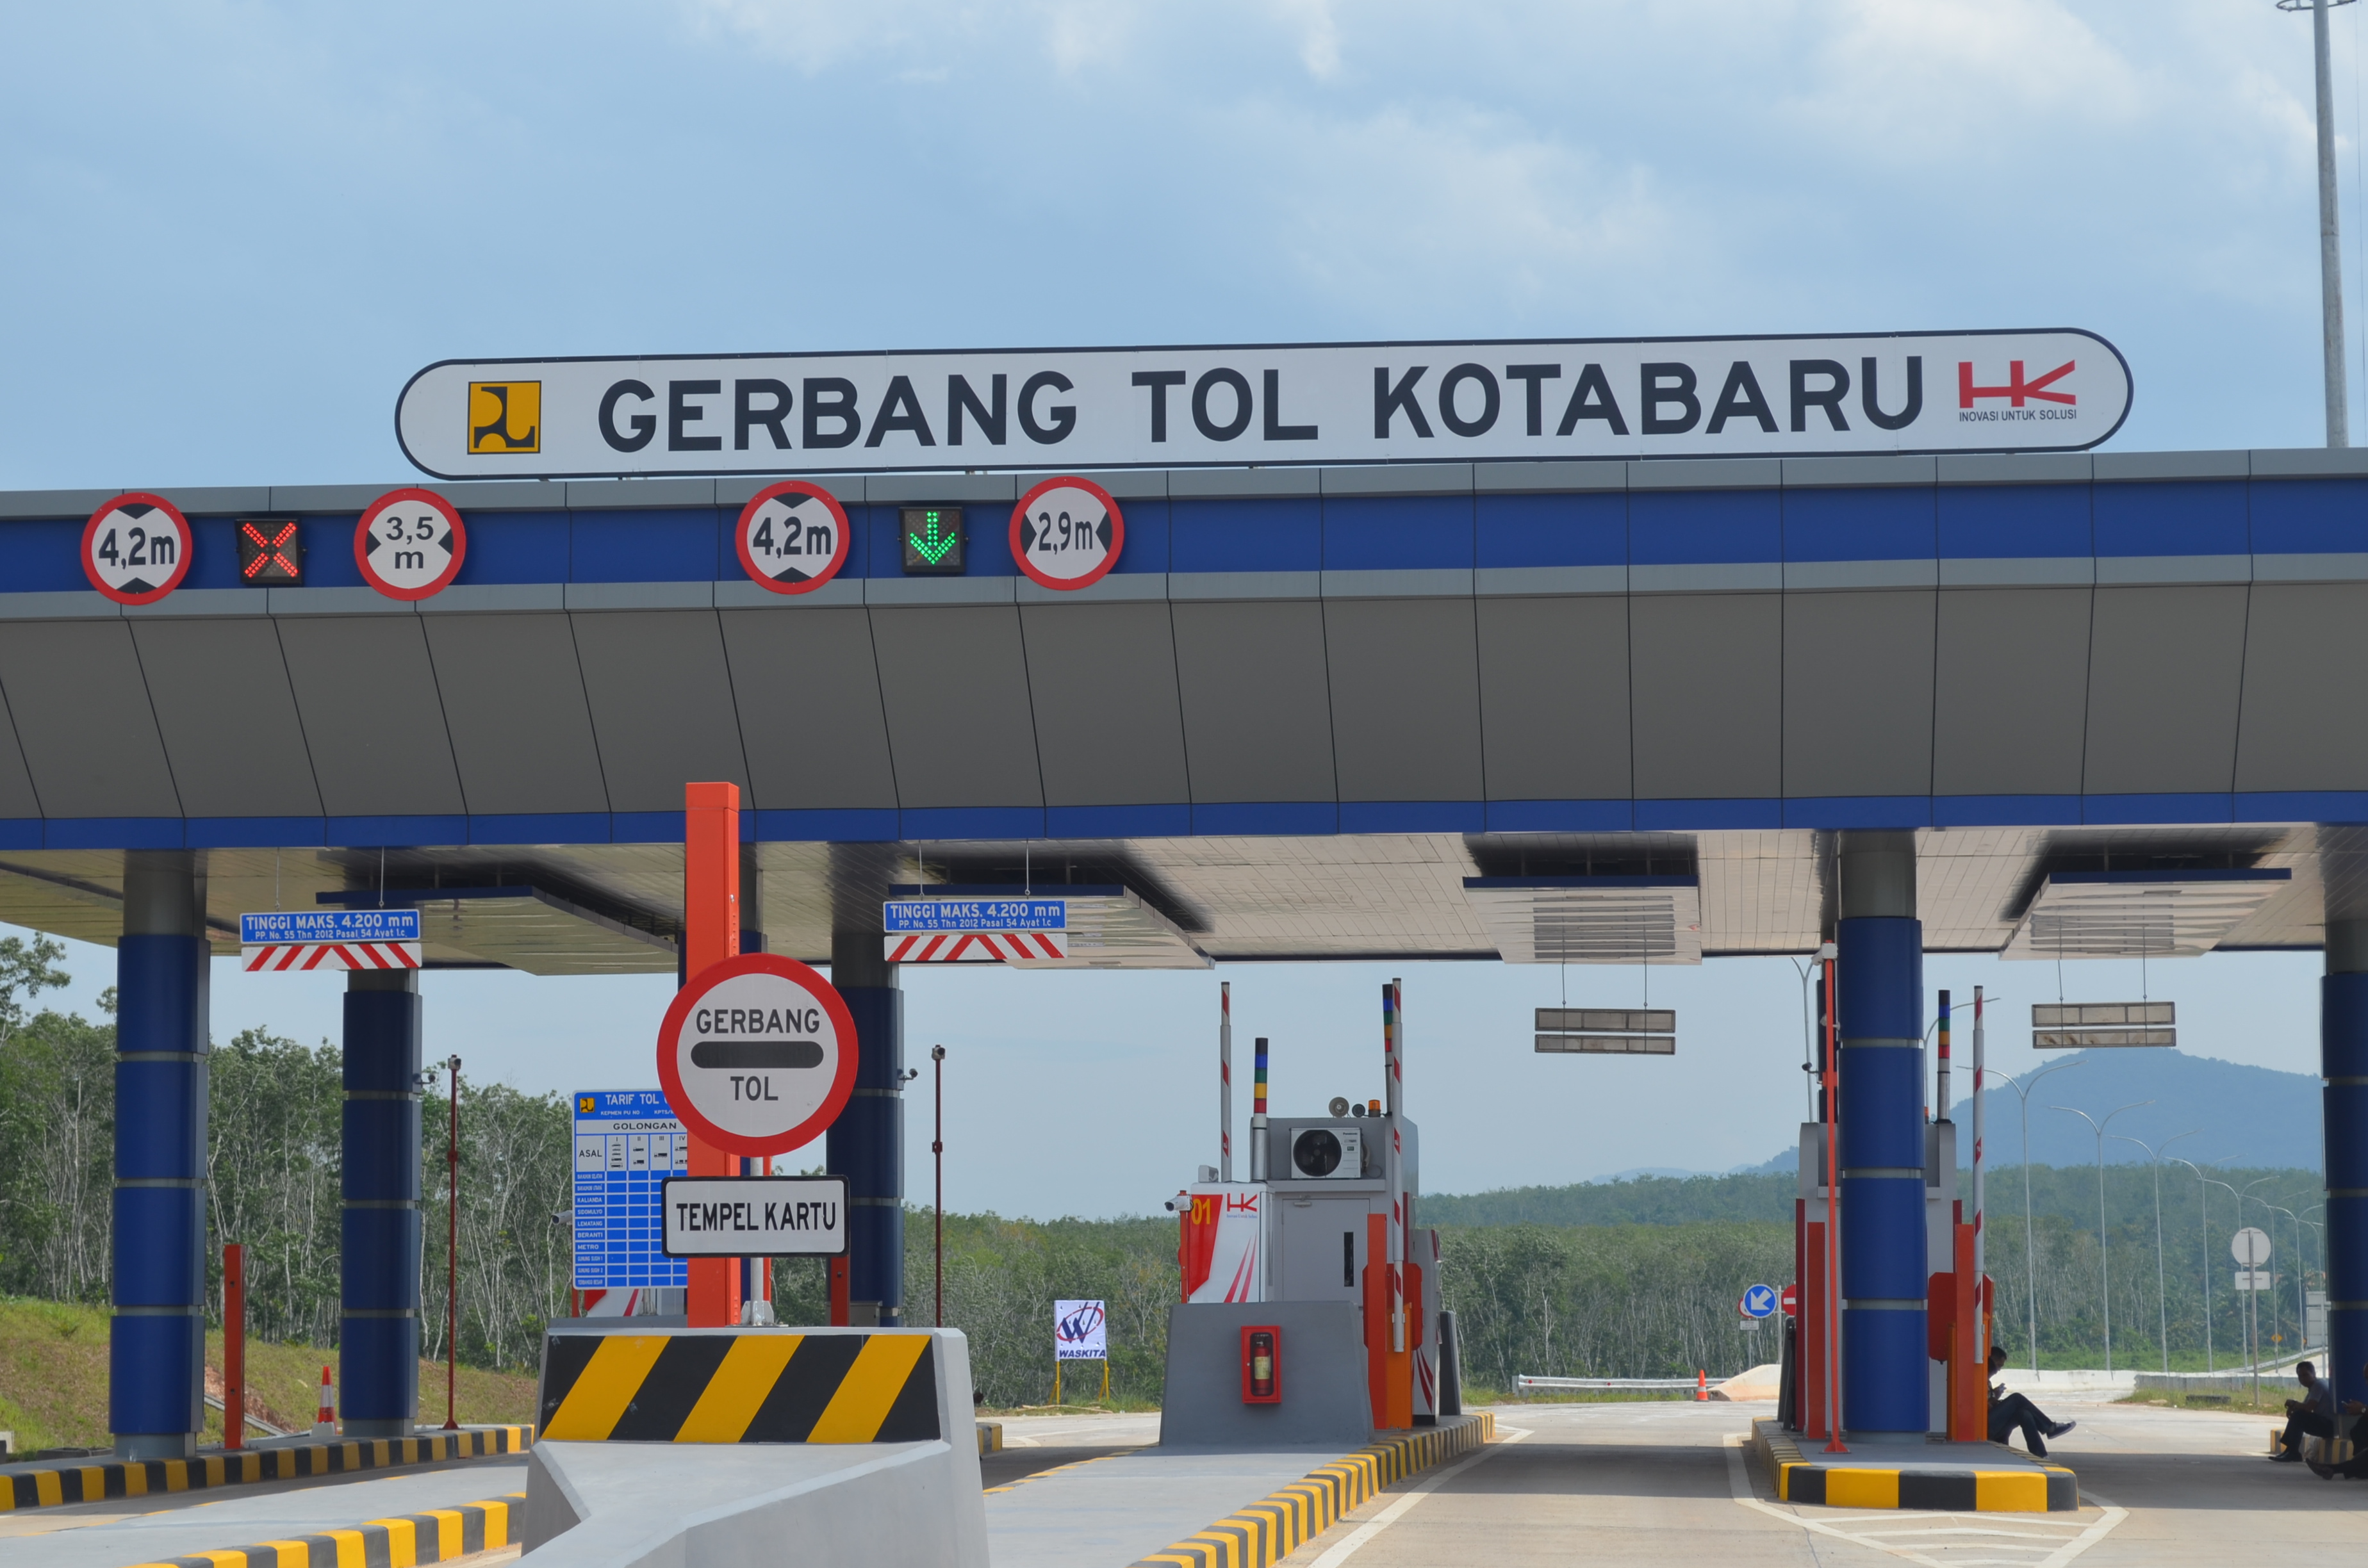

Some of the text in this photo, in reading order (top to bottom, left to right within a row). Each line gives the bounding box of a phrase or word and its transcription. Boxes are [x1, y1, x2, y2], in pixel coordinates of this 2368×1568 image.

[1959, 359, 2076, 409] HK
[598, 356, 1922, 452] GERBANG TOL KOTABARU
[1959, 409, 2076, 421] INOVASI UNTUK SOLUSI
[386, 517, 433, 544] 3,5
[753, 516, 832, 558] 4,2m
[1039, 512, 1092, 555] 2,9m
[98, 527, 175, 569] 4,2m
[395, 551, 423, 569] m
[246, 913, 413, 929] TINGGI MAKS. 4.200 mm
[890, 903, 1060, 919] TINGGI MAKS. 4.200 mm
[899, 920, 911, 928] PP.
[913, 920, 925, 928] No.
[928, 919, 938, 927] 55
[941, 919, 957, 927] Thn
[960, 919, 978, 927] 2012
[982, 919, 1003, 927] Pasal
[1007, 919, 1017, 927] 54
[1020, 918, 1040, 928] Ayat
[256, 931, 267, 940] PP.
[284, 931, 295, 939] 55
[298, 931, 311, 939] Thn
[315, 930, 333, 938] 2012
[336, 929, 358, 938] Pasal
[374, 928, 393, 938] Ayat
[696, 1009, 820, 1034] GERBANG
[605, 1094, 634, 1105] TARIF
[639, 1094, 659, 1104] TOL
[730, 1076, 778, 1100] TOL
[613, 1122, 677, 1131] GOLONGAN
[1192, 1198, 1210, 1225] 01
[1227, 1193, 1257, 1212] HK
[677, 1202, 835, 1231] TEMPEL KARTU
